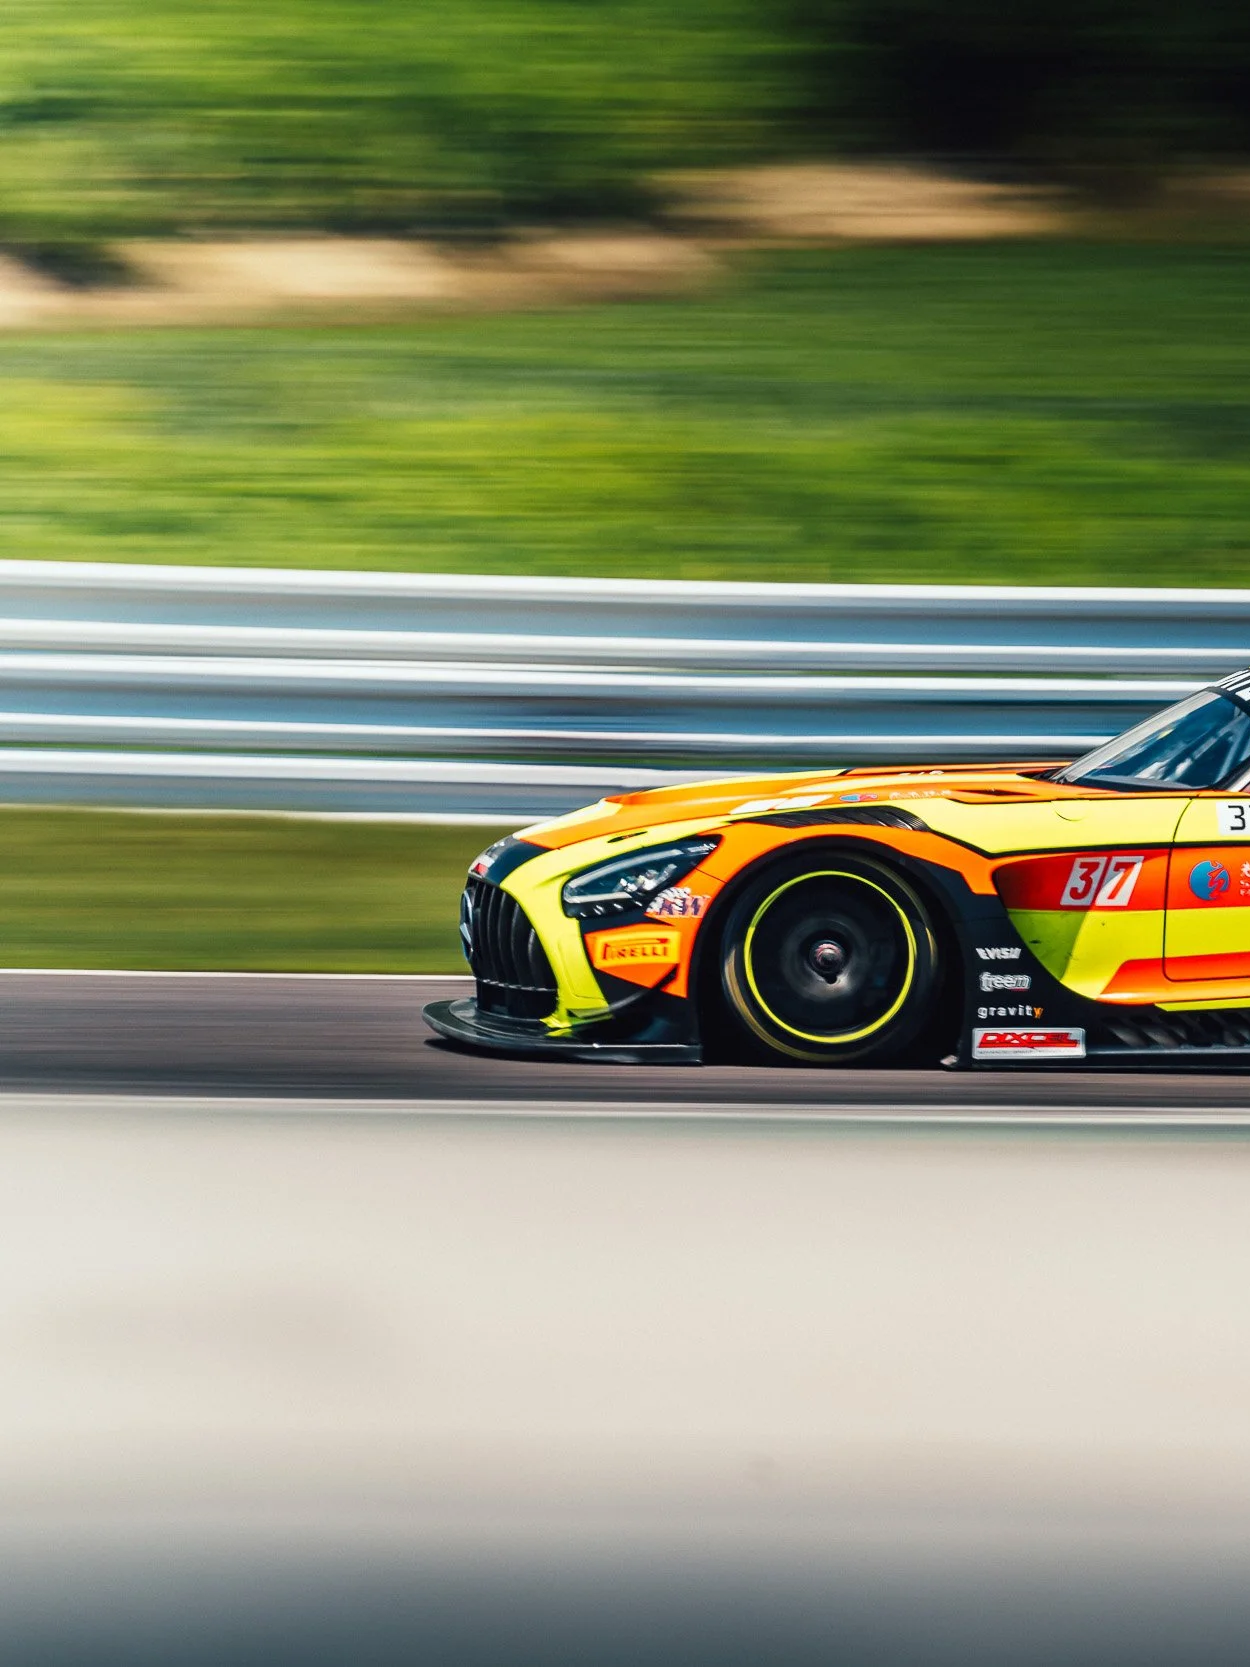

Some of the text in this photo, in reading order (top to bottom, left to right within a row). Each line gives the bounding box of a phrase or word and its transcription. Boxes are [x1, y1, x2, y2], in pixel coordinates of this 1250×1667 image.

[1068, 861, 1138, 901] 37
[602, 937, 670, 961] PIRELLI
[977, 1004, 1044, 1019] gravity
